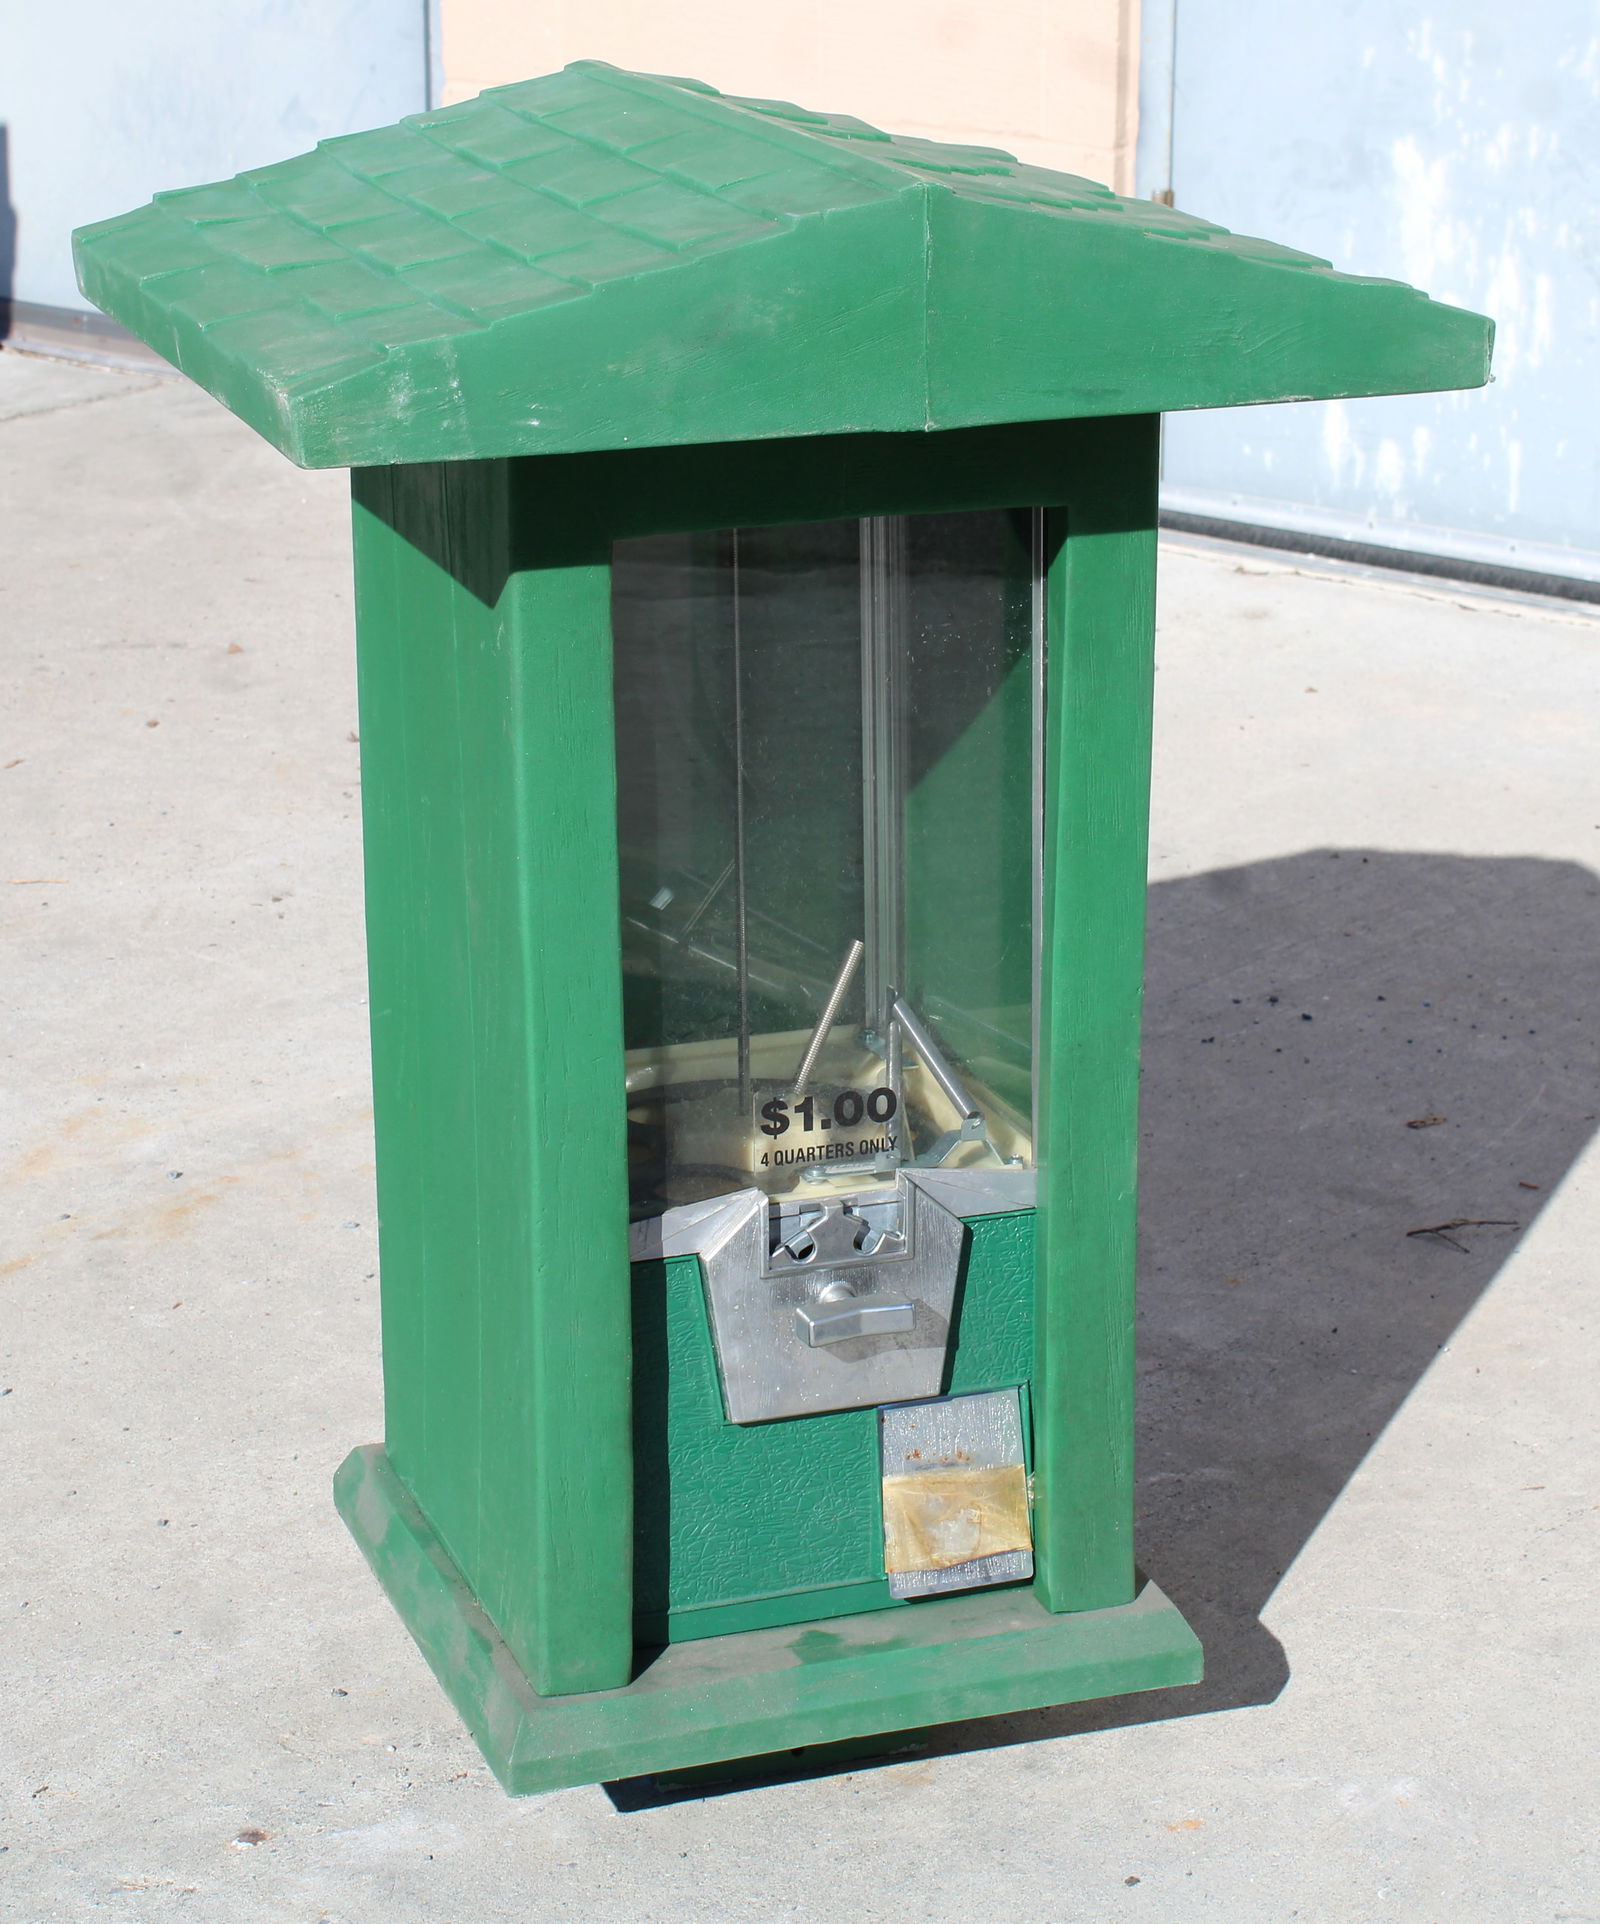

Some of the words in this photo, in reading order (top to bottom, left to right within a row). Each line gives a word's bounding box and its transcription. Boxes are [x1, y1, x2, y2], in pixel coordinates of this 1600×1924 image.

[760, 1087, 897, 1140] $1.00
[760, 1152, 770, 1167] 4
[774, 1142, 854, 1166] QUARTERS
[859, 1136, 897, 1155] ONLY
